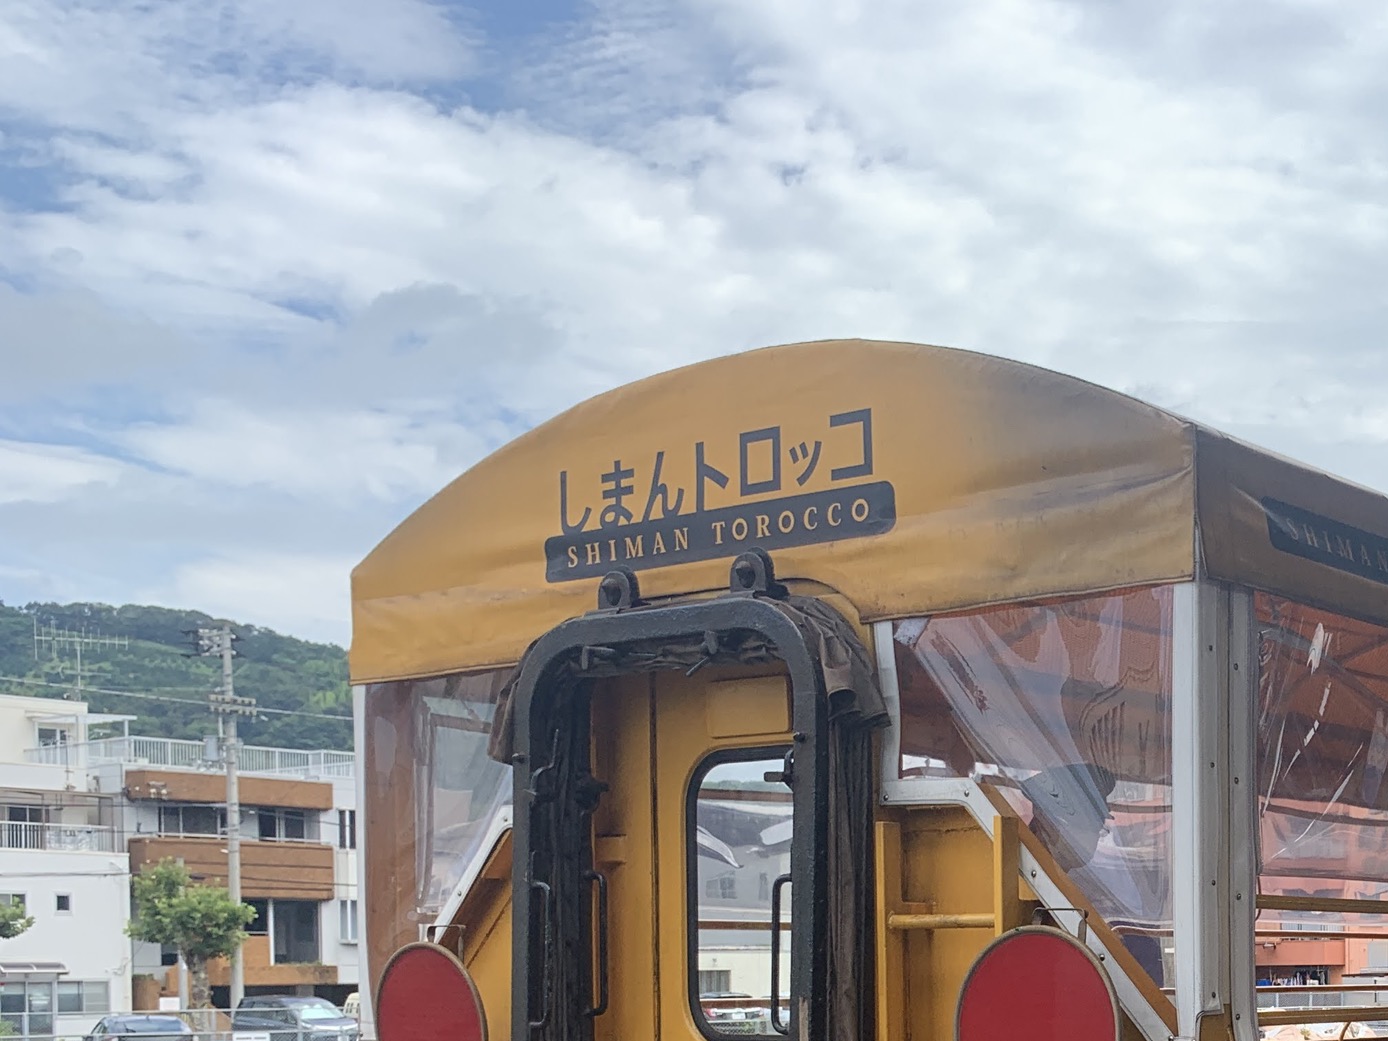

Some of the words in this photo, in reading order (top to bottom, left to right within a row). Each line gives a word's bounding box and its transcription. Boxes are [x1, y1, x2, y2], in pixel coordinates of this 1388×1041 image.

[560, 408, 874, 533] しまんトロッコ
[567, 527, 689, 568] SHIMAN
[711, 498, 870, 545] TOROCCO
[1286, 517, 1388, 574] SHIMAN
